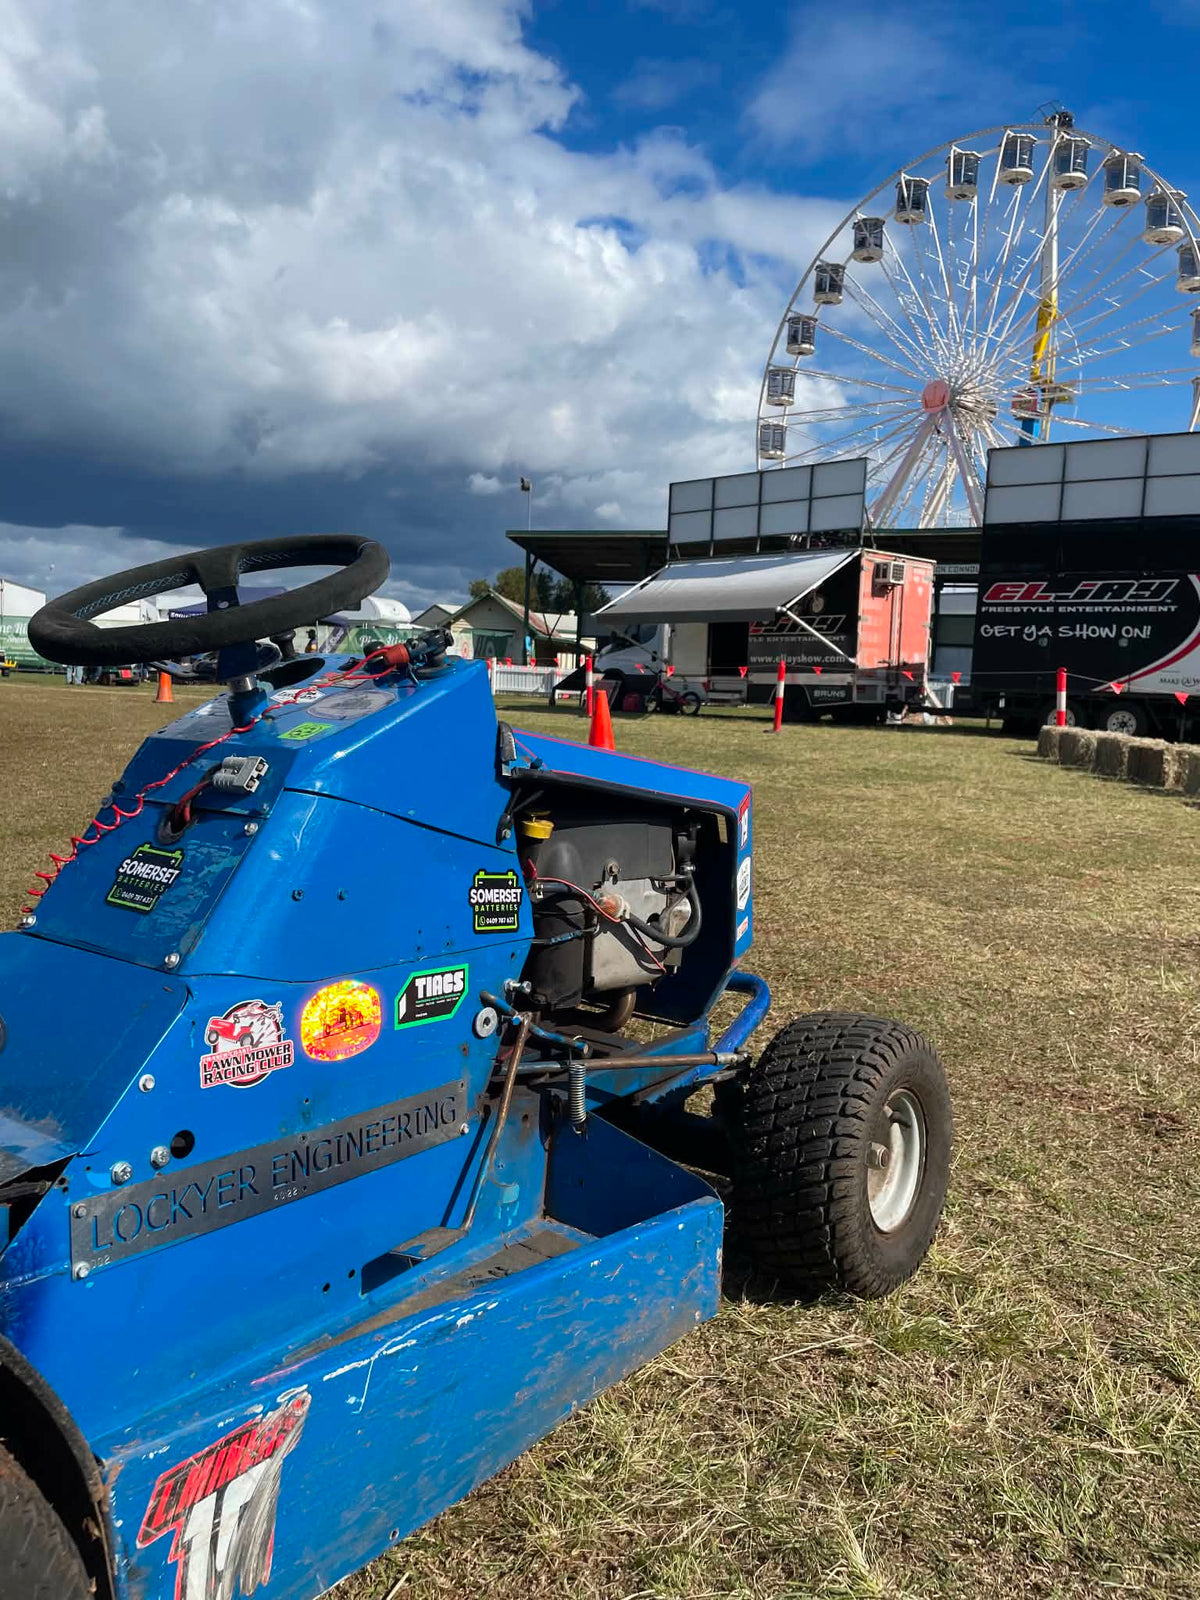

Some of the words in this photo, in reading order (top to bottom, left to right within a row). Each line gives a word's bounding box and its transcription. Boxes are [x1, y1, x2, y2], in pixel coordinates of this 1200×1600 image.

[981, 605, 1054, 613] FREESTYLE
[1058, 605, 1178, 613] ENTERTAINMENT
[980, 624, 1021, 637] GET
[1058, 623, 1117, 640] SHOW
[813, 689, 846, 698] BRUNS
[119, 859, 181, 884] SOMERSET
[117, 875, 166, 892] BATTERIES
[470, 888, 522, 903] SOMERSET
[475, 904, 518, 912] BATTERIES
[203, 1056, 241, 1073] LAWN
[244, 1043, 291, 1062] MOWER
[203, 1062, 255, 1085] RACING
[260, 1053, 291, 1070] CLUB
[91, 1165, 260, 1252] LOCKYER
[271, 1096, 457, 1189] ENGINEERING
